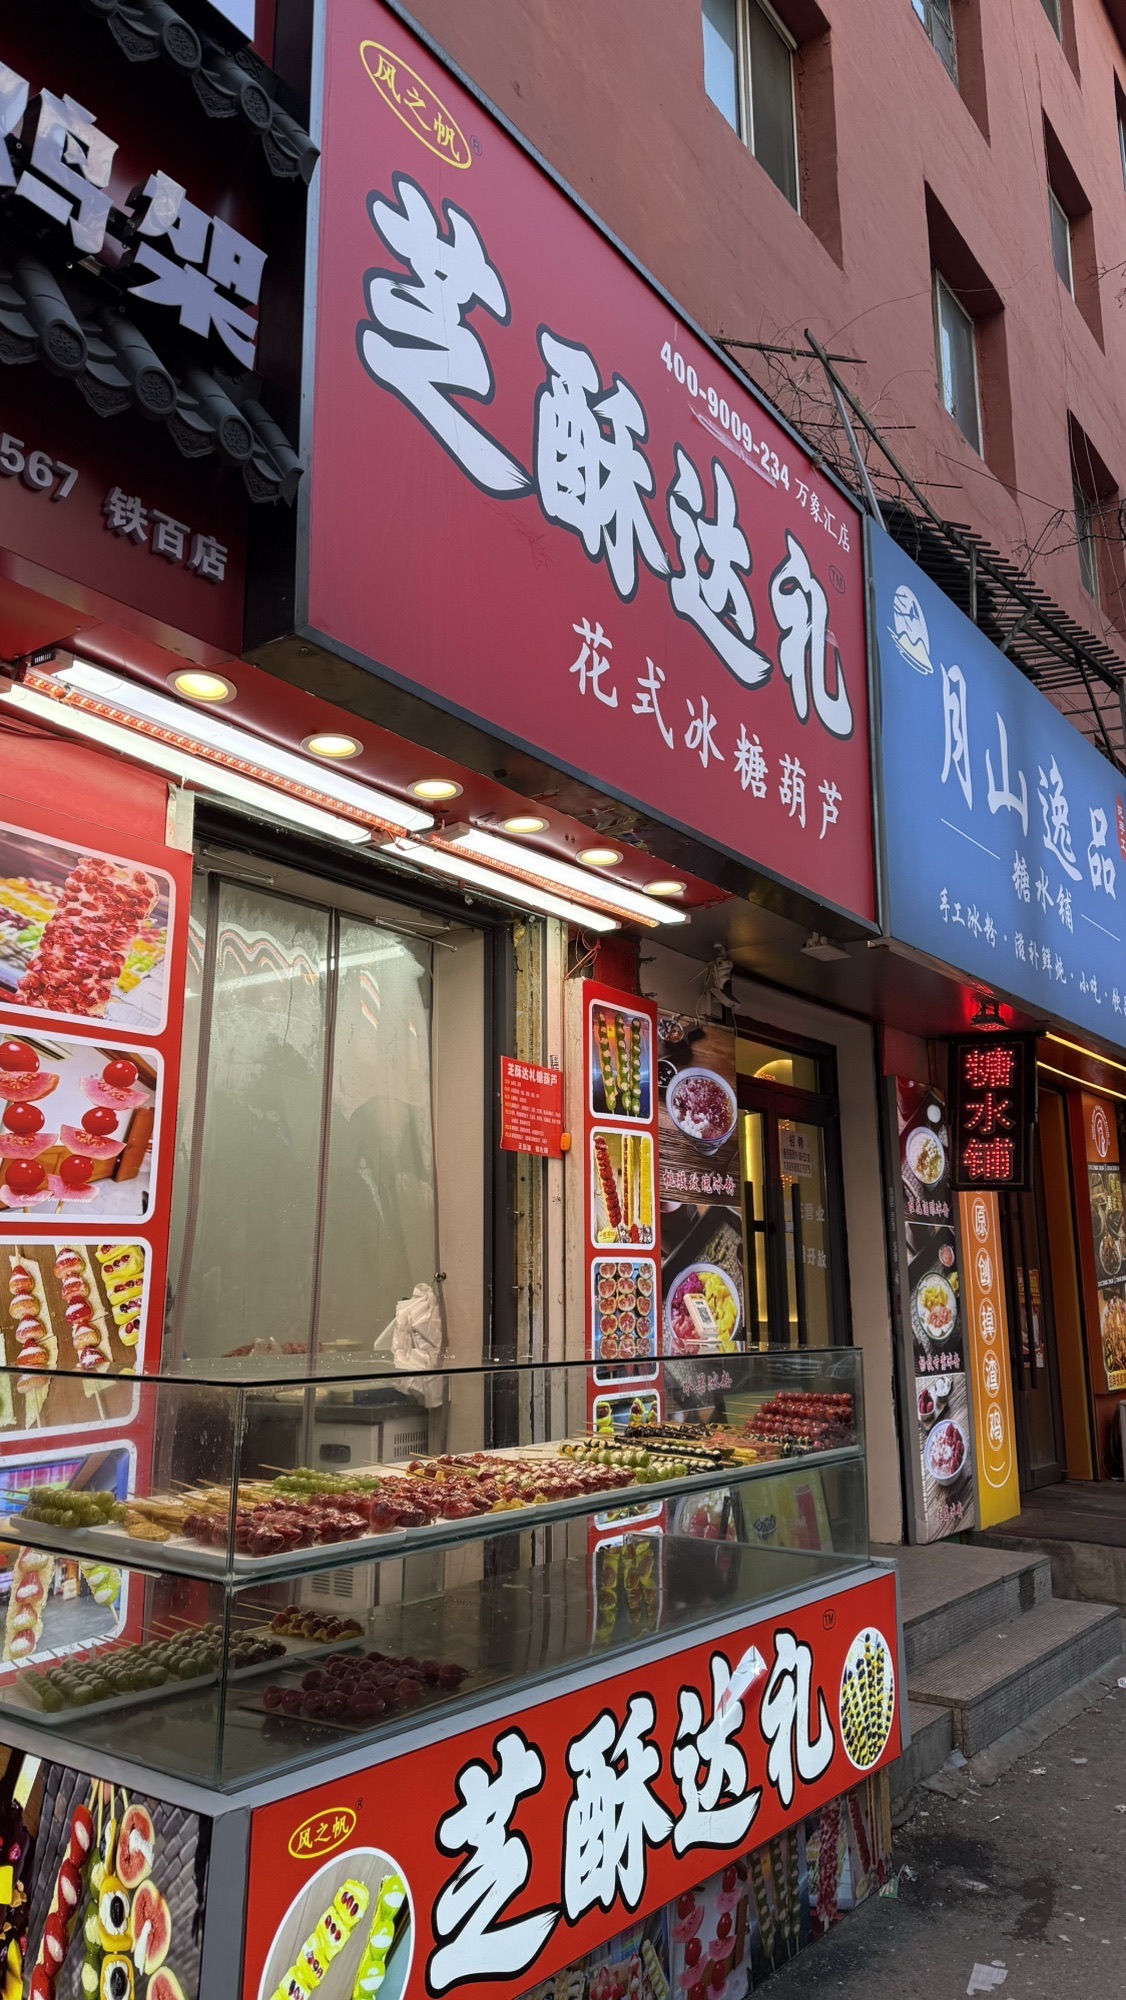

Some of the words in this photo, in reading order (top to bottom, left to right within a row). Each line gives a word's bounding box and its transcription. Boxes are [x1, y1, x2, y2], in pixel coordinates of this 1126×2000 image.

[373, 54, 460, 161] 风之帆
[356, 172, 853, 739] 芝酥达礼
[660, 340, 790, 491] 400-9009-234
[795, 477, 850, 553] 万象汇店
[105, 487, 229, 582] 铁百店
[569, 617, 842, 839] 花式冰糖葫芦
[940, 663, 1116, 899] 月山逸品
[1013, 850, 1073, 934] 糖水铺
[964, 1048, 1016, 1180] 糖水铺
[296, 1816, 349, 1852] 风之帆
